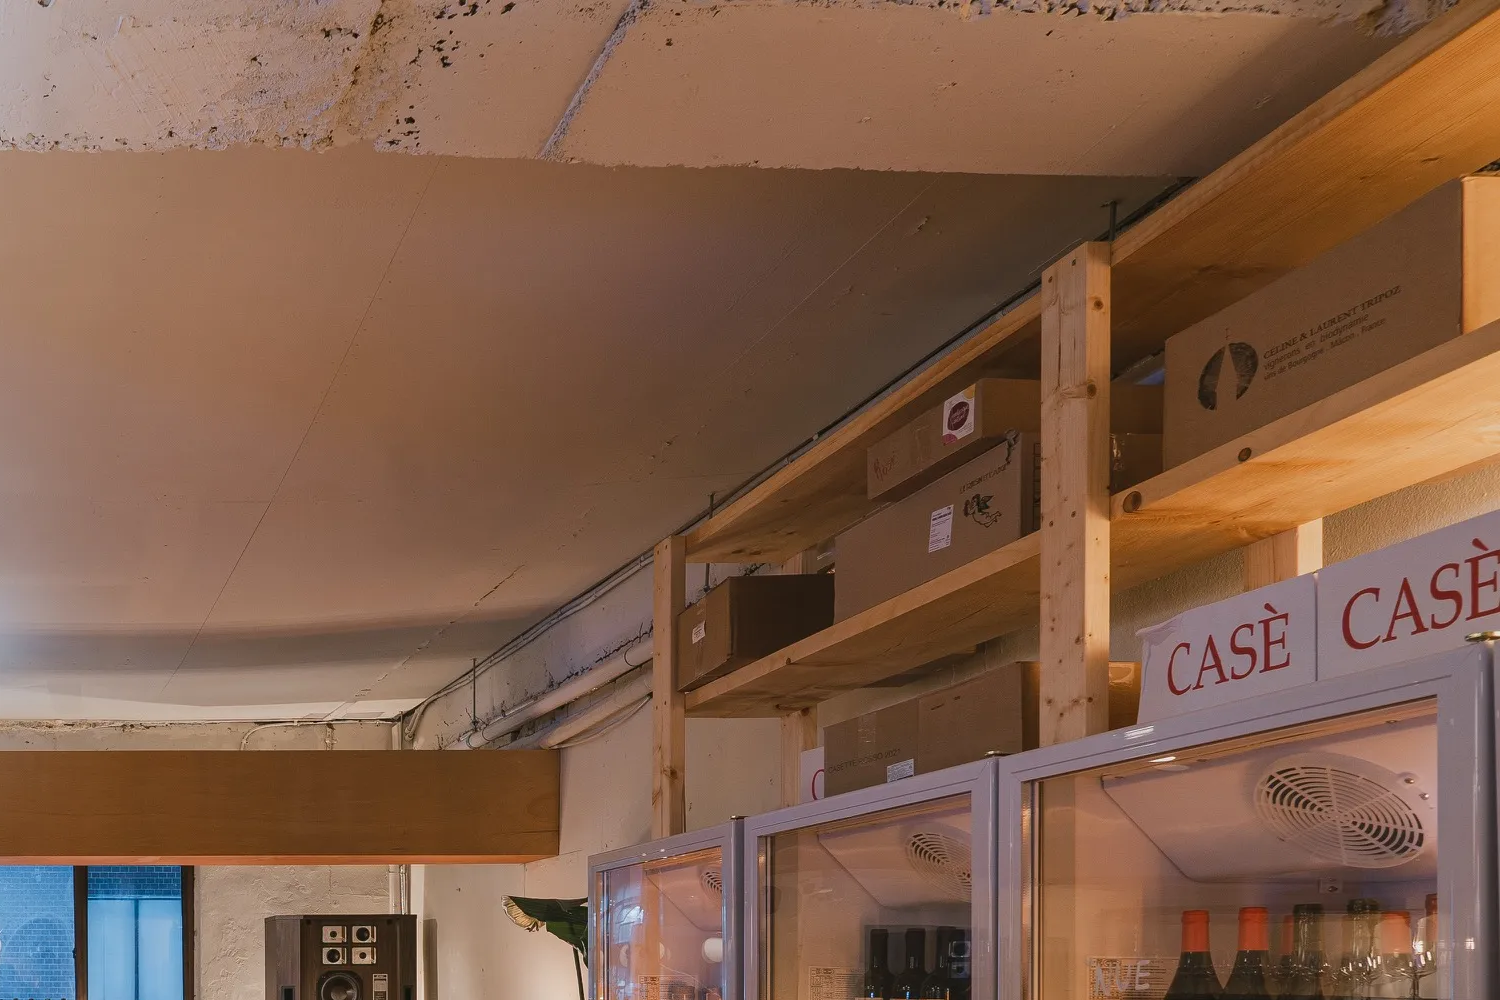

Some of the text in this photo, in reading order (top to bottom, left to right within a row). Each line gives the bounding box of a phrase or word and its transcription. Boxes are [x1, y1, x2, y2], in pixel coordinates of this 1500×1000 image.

[1309, 308, 1358, 338] LAURENT
[1361, 285, 1402, 311] TRIPOZ
[1342, 538, 1500, 650] CASÈ
[1167, 603, 1290, 696] CASÈ
